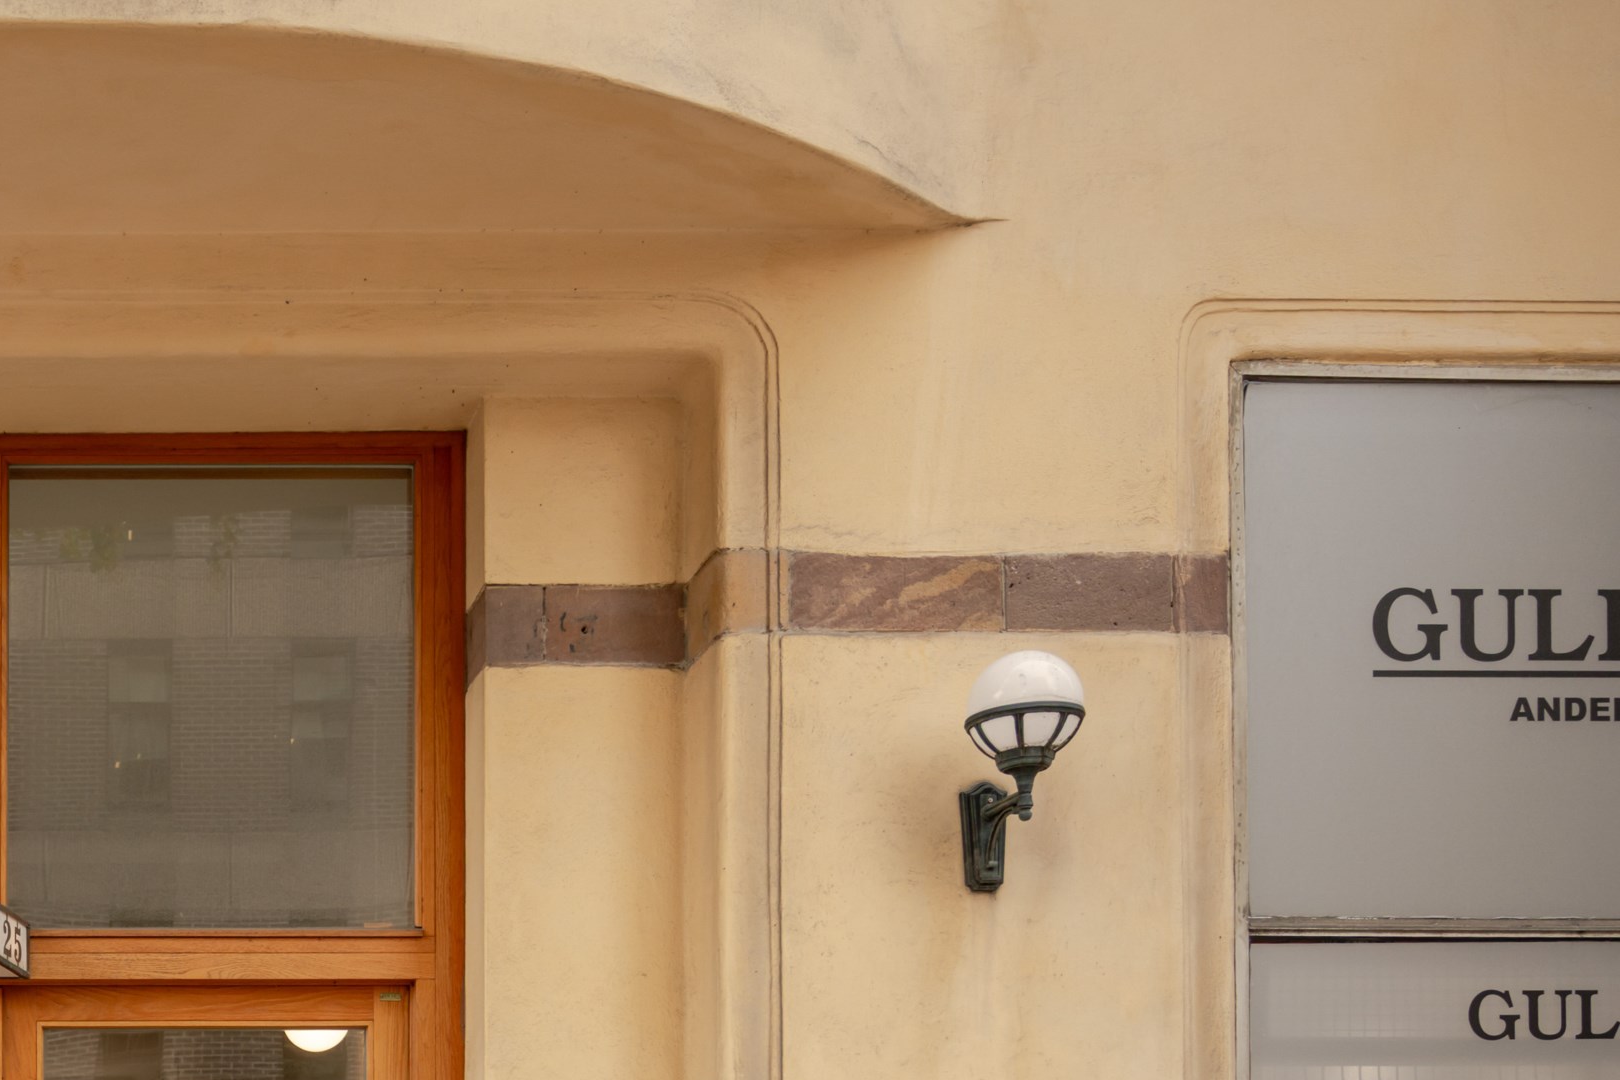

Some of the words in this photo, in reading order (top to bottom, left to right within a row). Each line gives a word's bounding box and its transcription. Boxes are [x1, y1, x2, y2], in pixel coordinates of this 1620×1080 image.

[1509, 697, 1620, 722] ANDE
[3, 919, 22, 963] 25
[1468, 989, 1620, 1040] GUL
